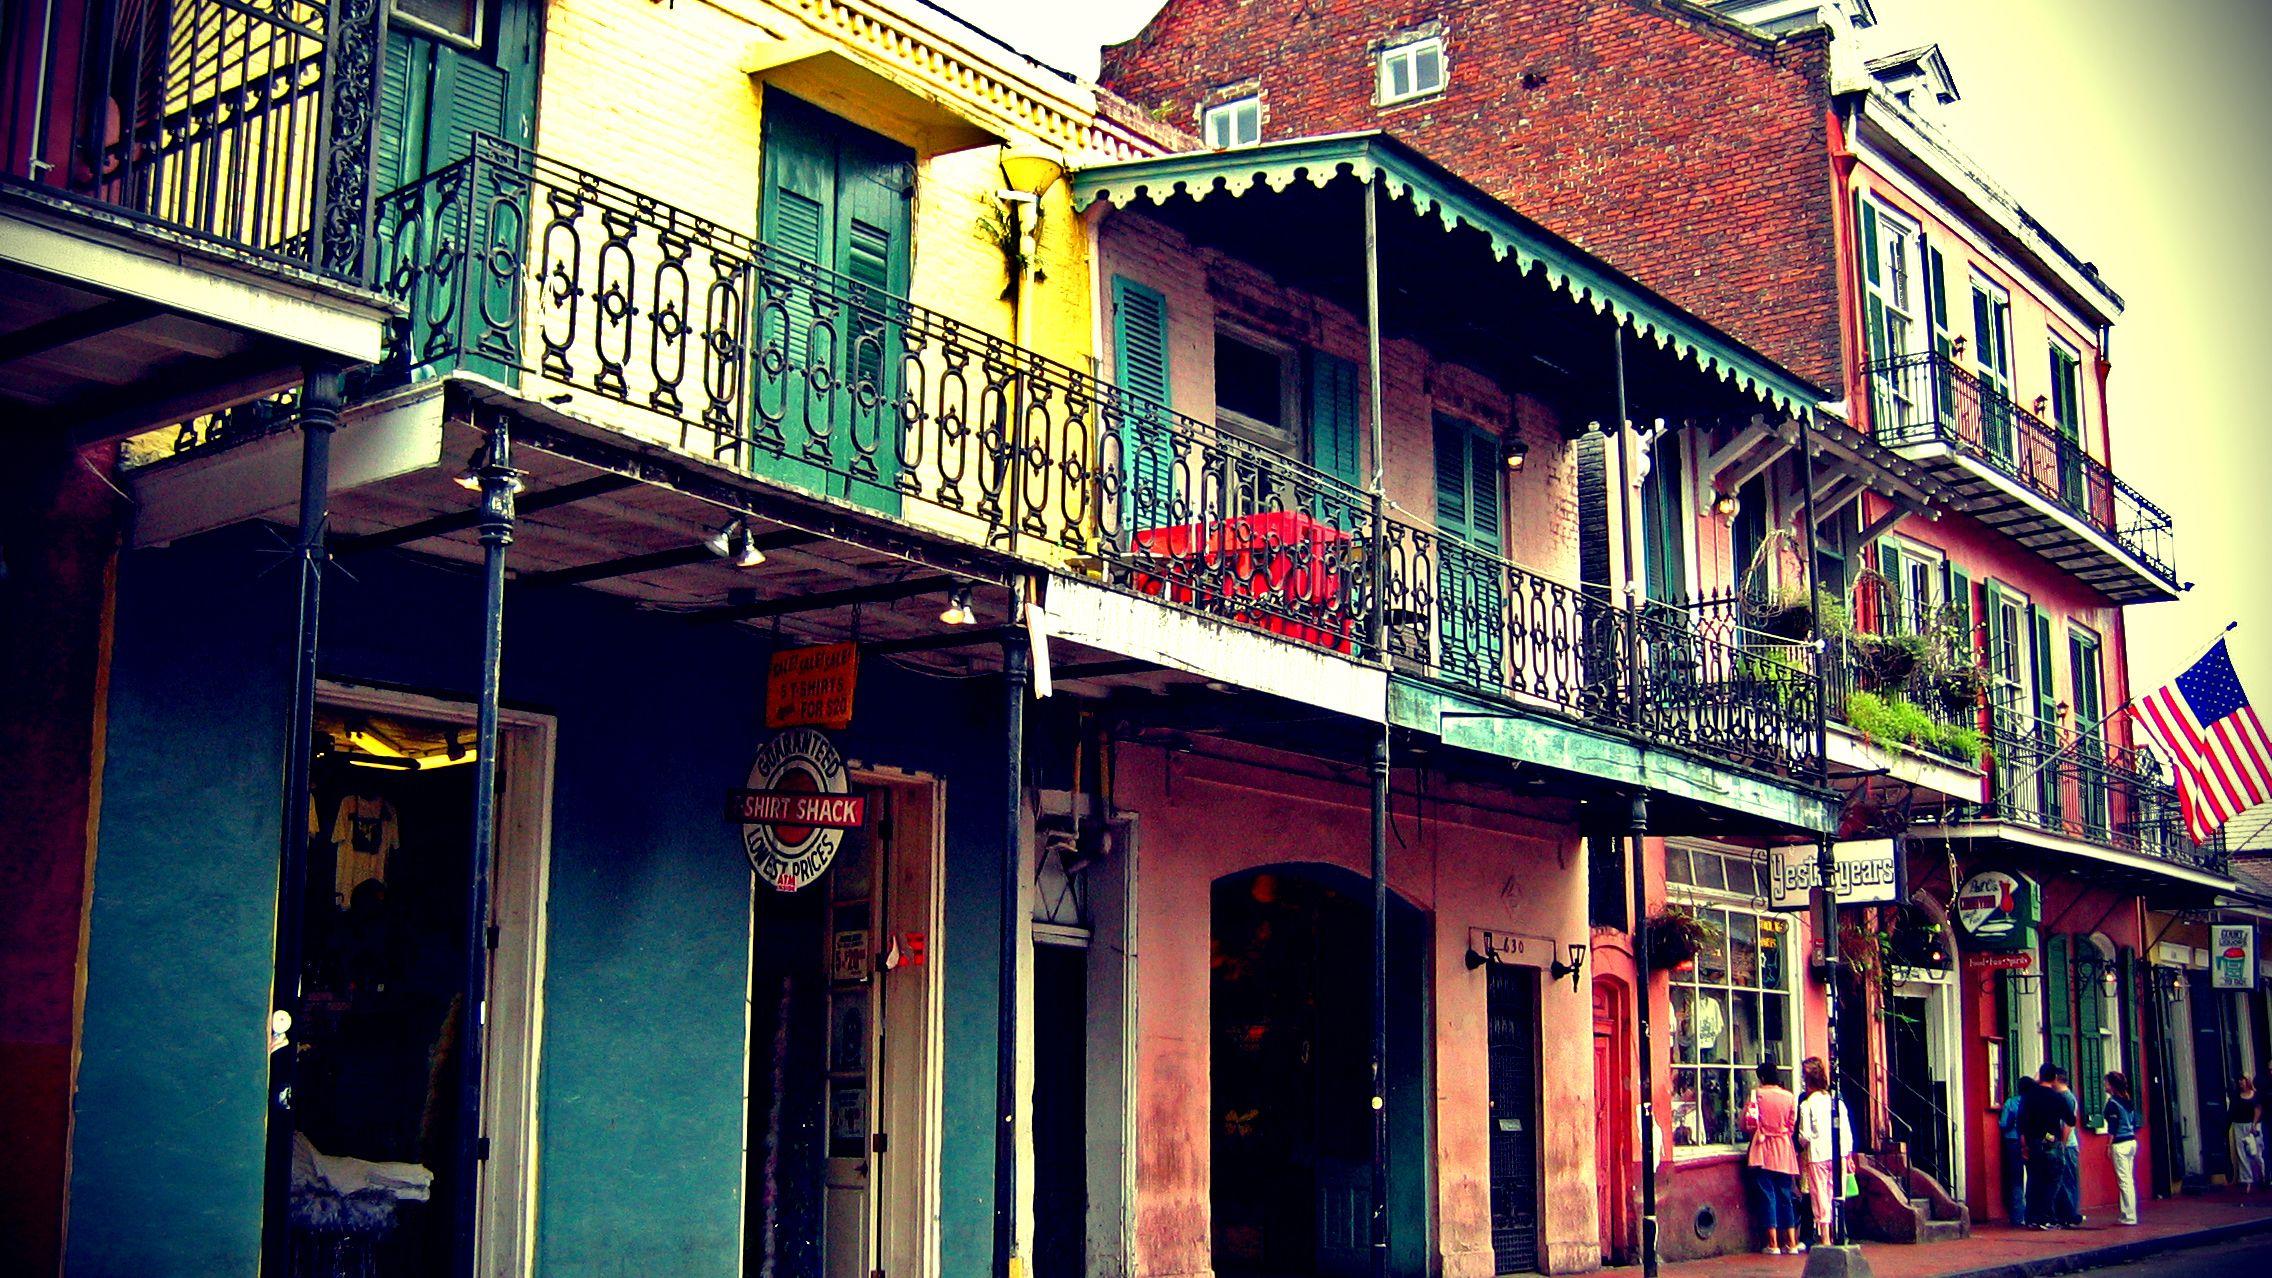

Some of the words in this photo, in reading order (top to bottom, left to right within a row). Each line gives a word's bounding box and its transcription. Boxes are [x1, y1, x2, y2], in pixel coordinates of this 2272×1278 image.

[800, 699, 823, 719] FOR
[757, 731, 840, 778] GUARANTEED
[796, 798, 857, 823] SHACK
[747, 827, 788, 880] LOWEST
[793, 833, 833, 882] PRICES
[778, 874, 795, 885] ATM
[1503, 937, 1524, 954] 630
